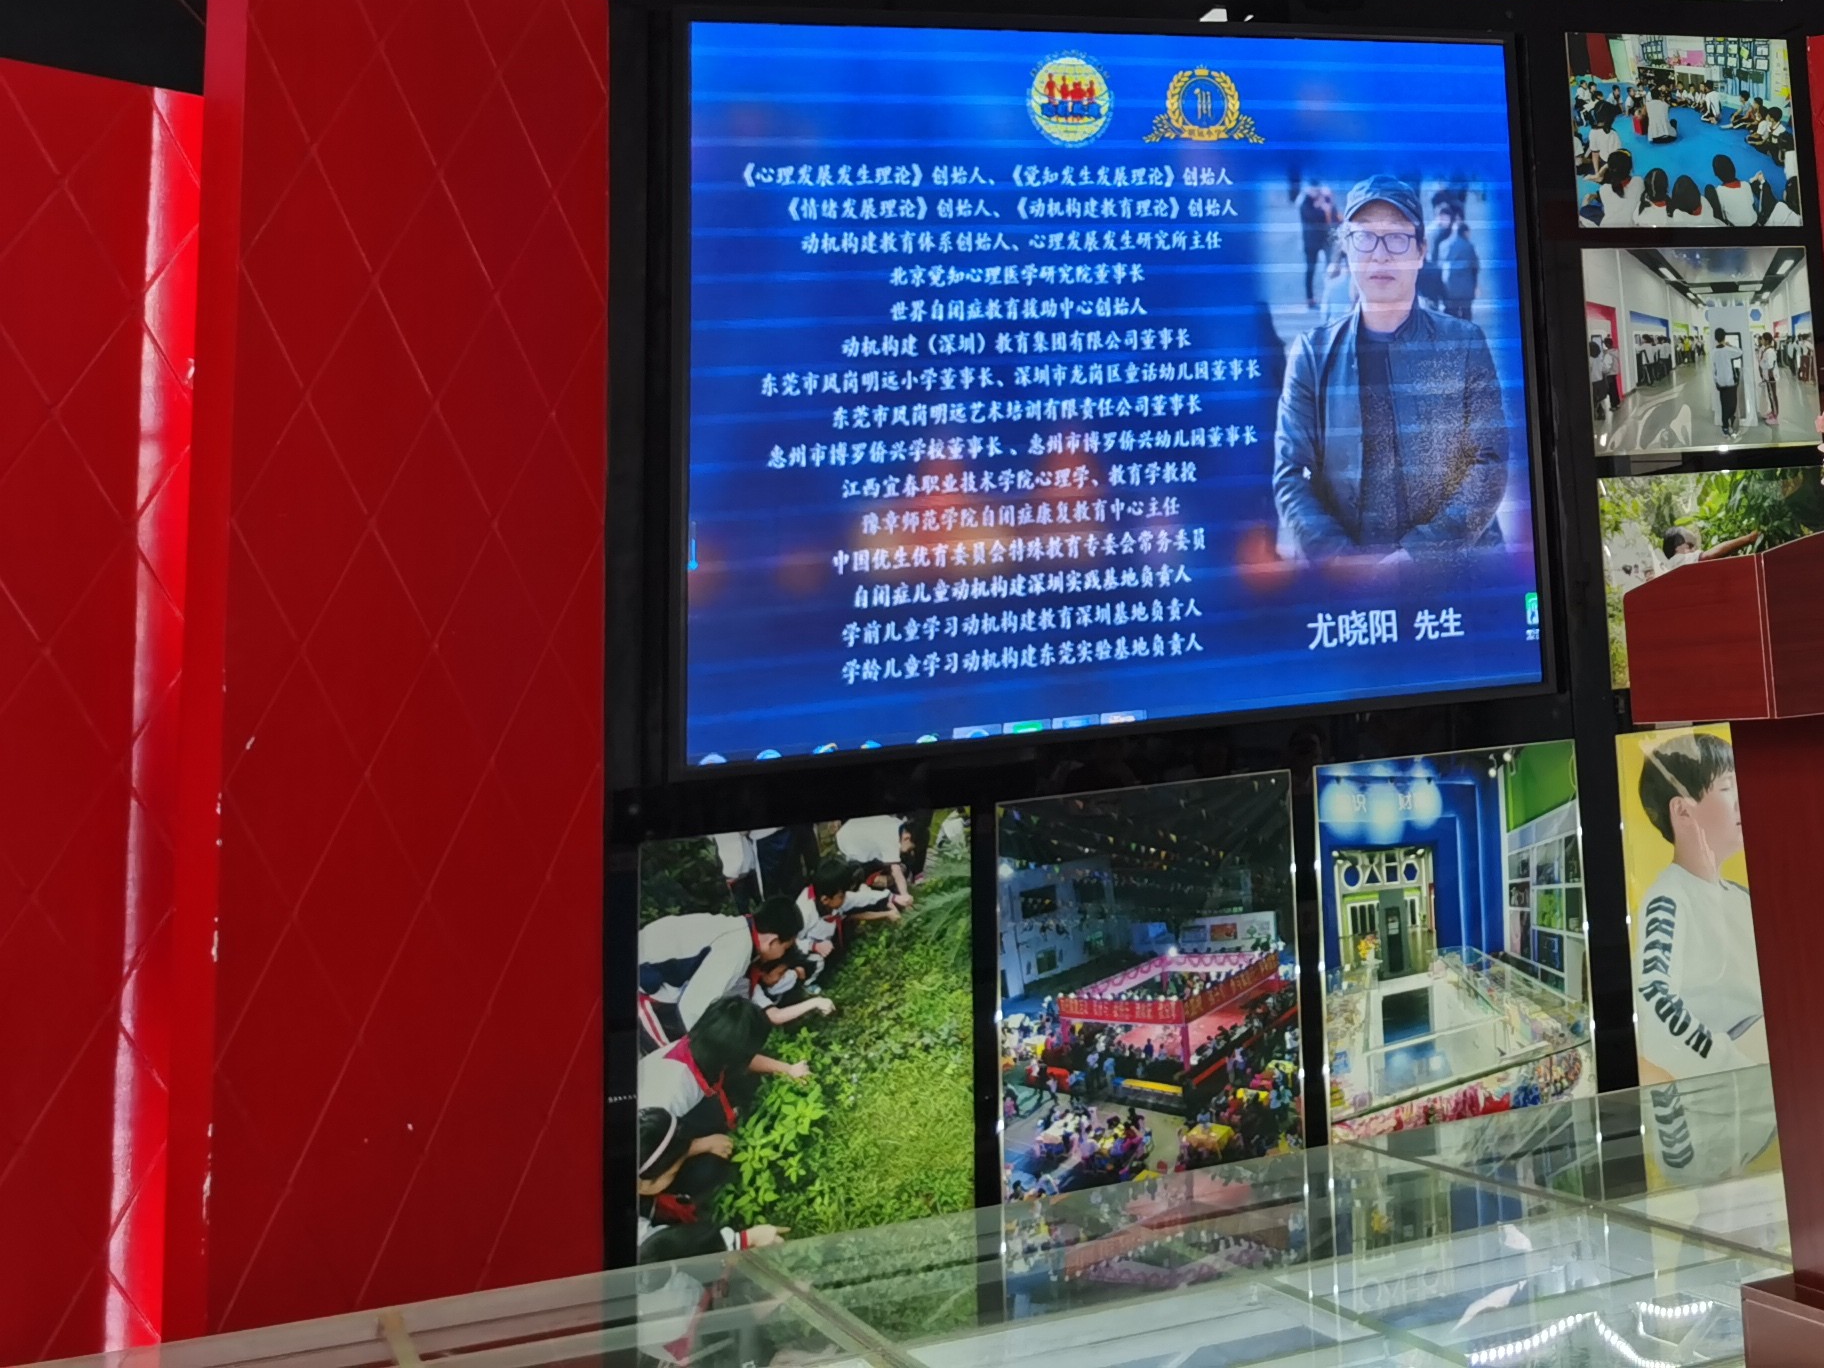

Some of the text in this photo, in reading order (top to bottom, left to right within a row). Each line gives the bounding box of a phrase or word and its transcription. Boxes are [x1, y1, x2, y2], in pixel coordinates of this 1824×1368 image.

[1307, 607, 1465, 650] 尤晓阳 先生
